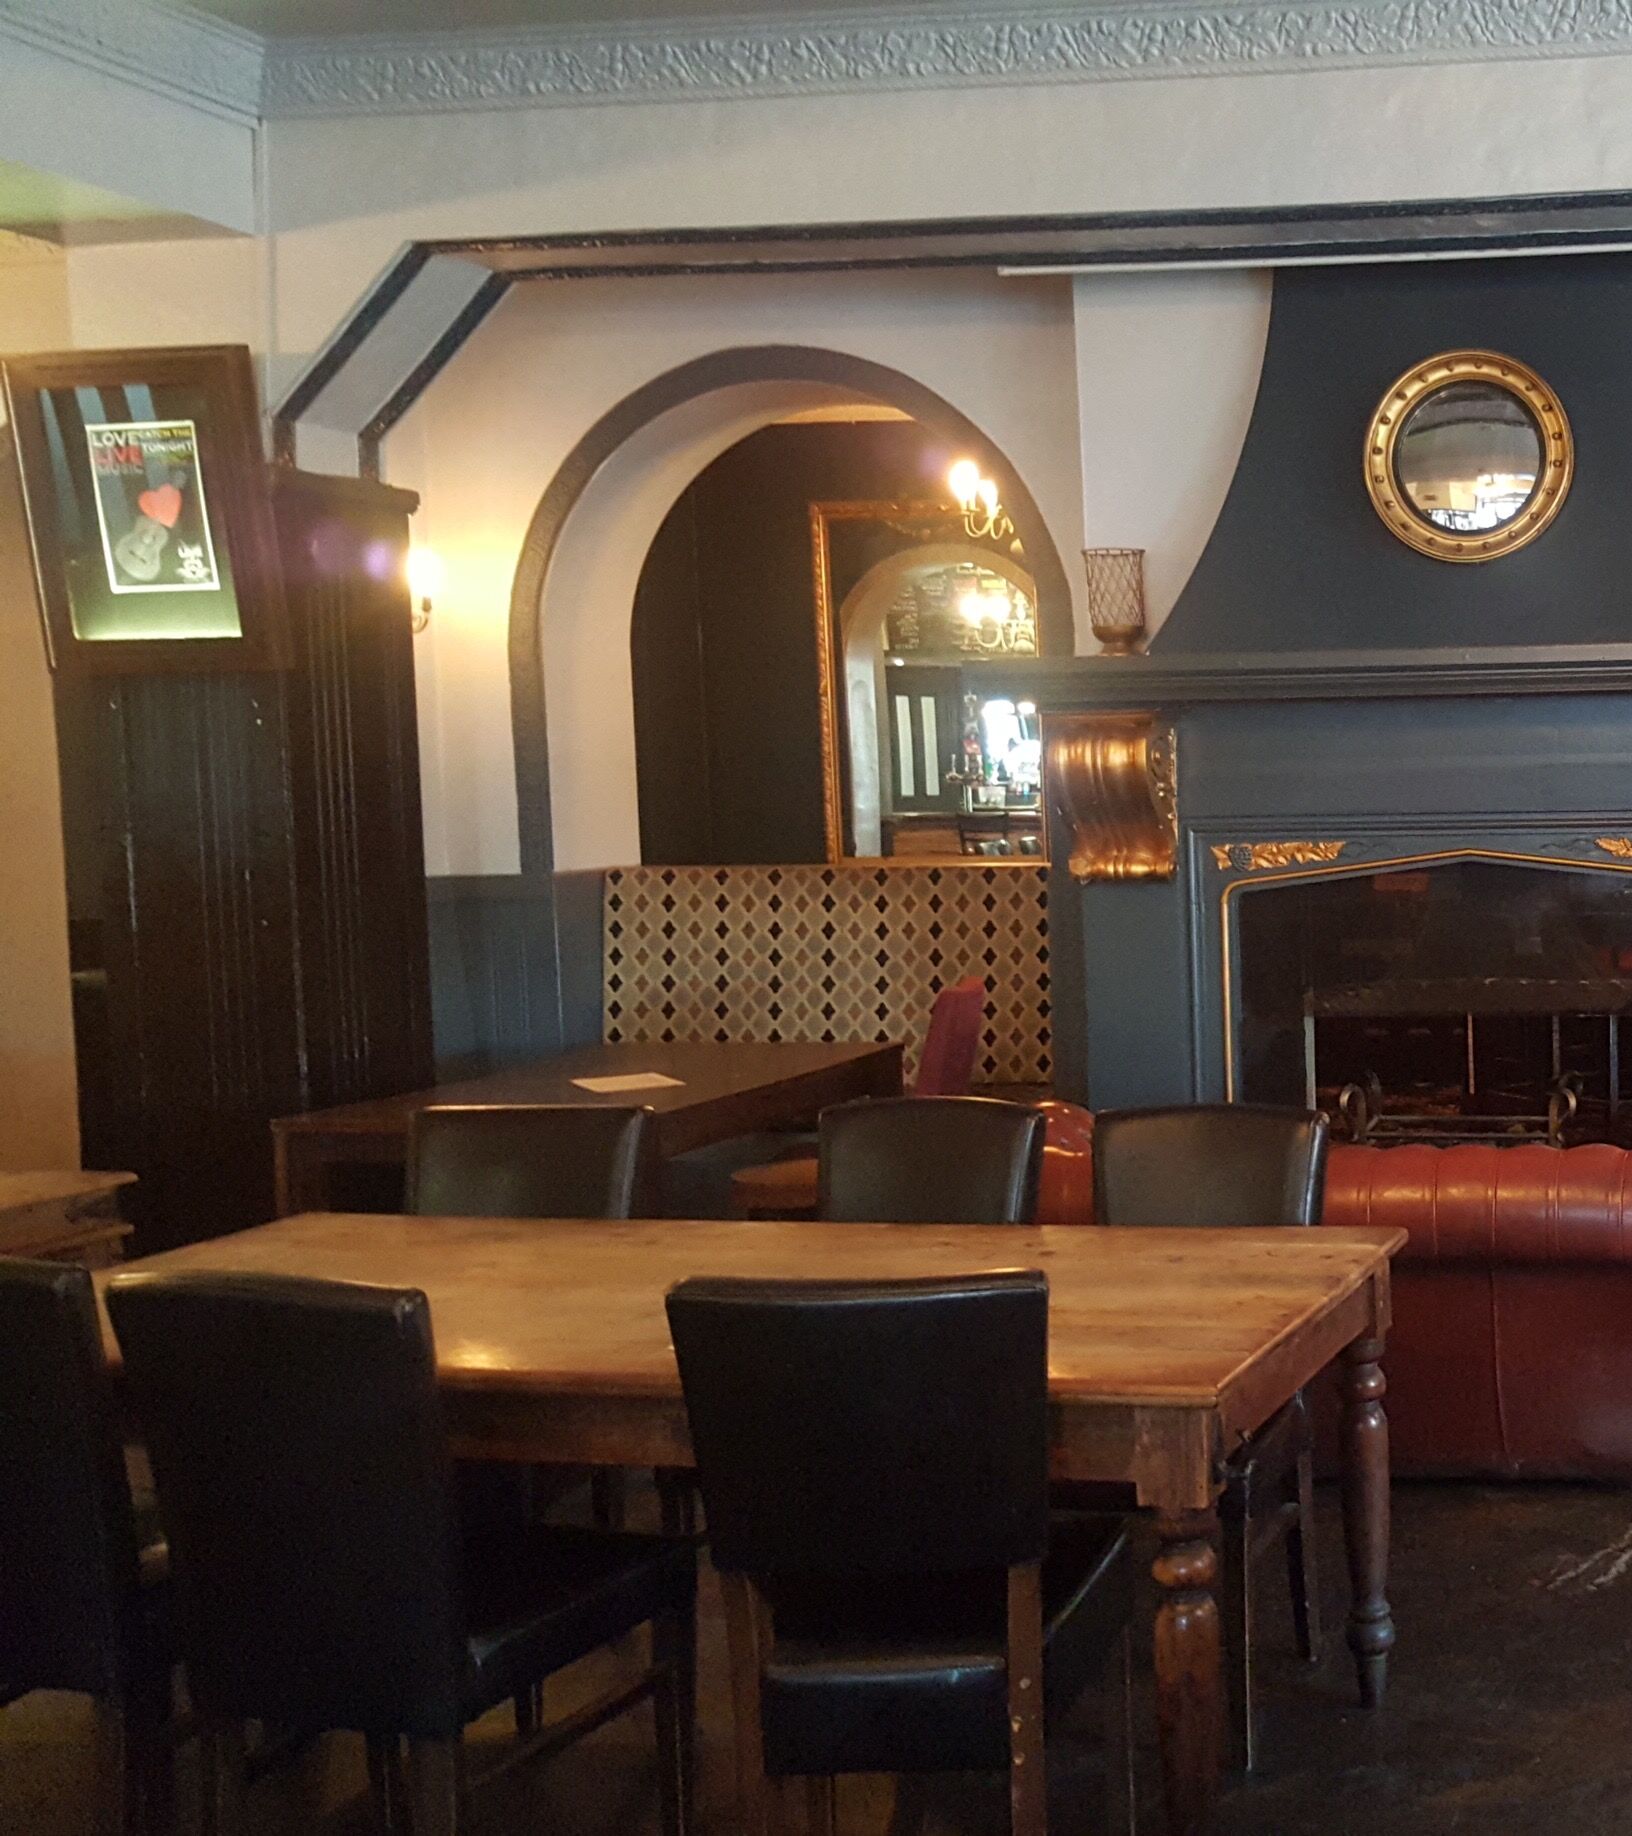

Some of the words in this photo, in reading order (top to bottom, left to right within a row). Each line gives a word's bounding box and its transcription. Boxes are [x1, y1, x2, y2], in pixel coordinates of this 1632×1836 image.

[92, 430, 141, 449] LOVE
[141, 439, 194, 453] TONIGHT
[94, 447, 144, 465] LIVE
